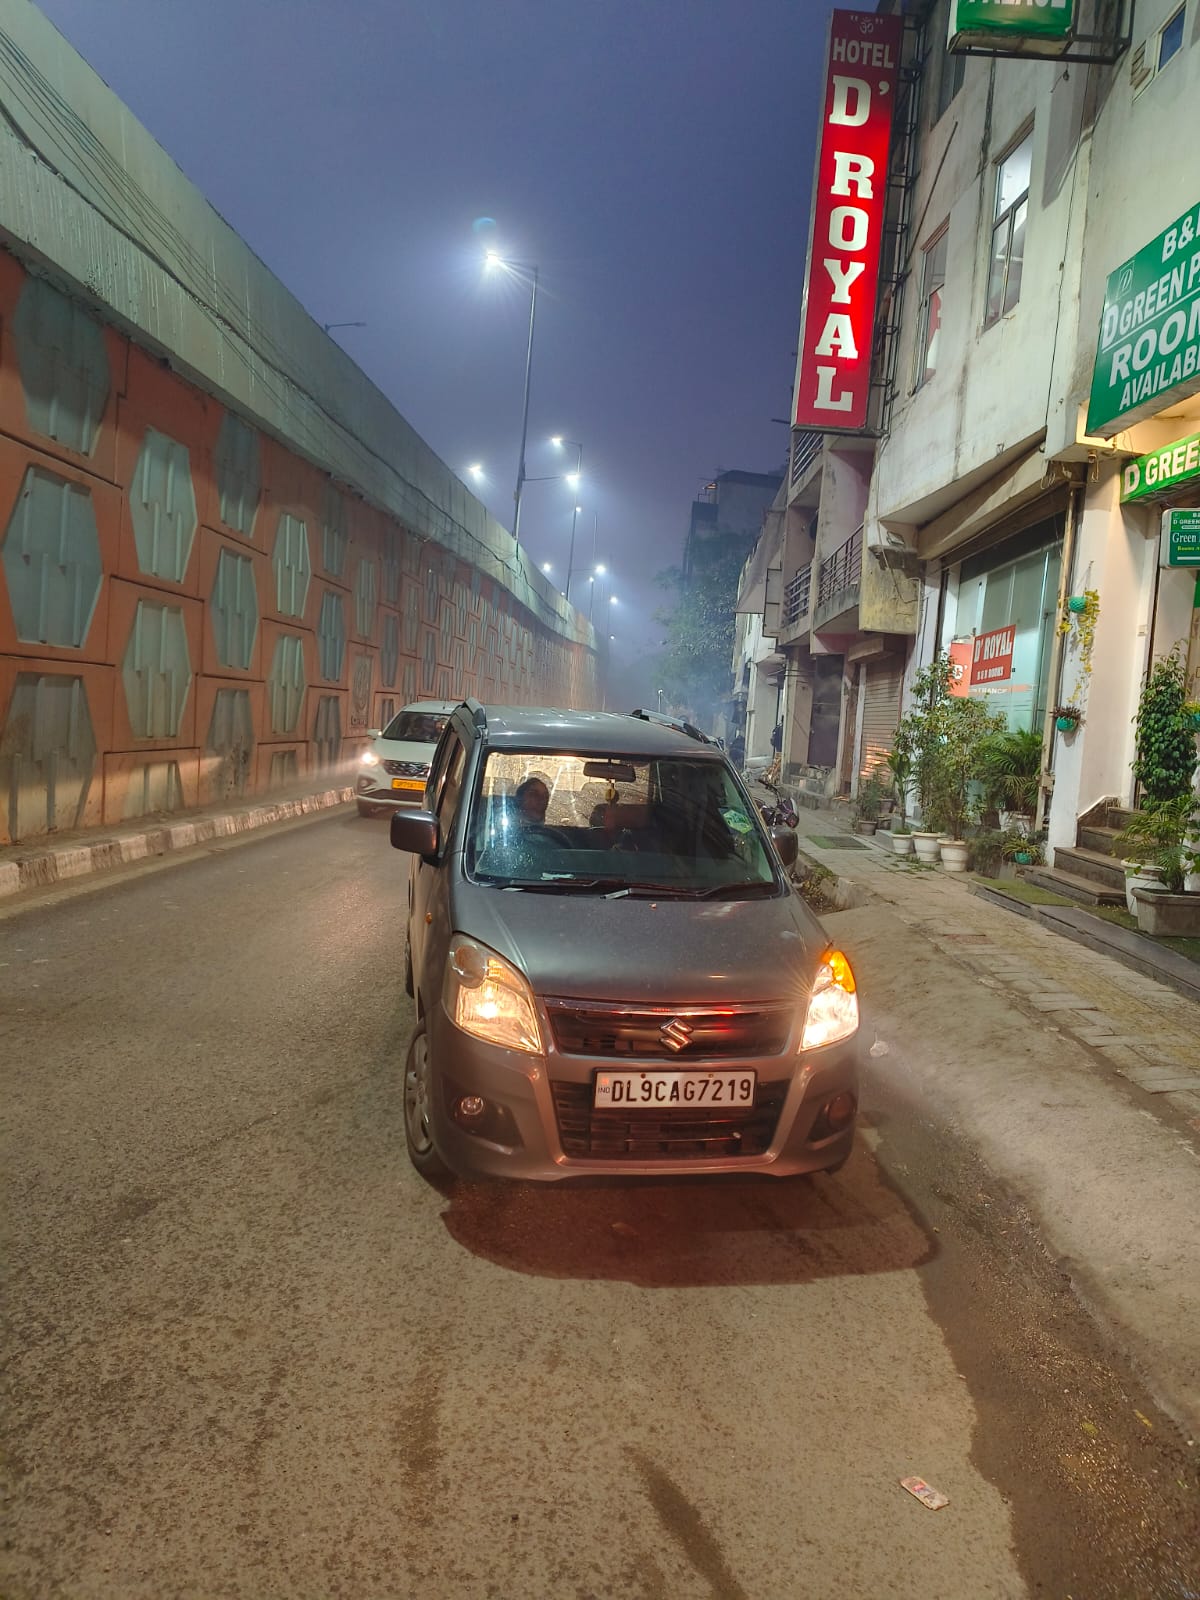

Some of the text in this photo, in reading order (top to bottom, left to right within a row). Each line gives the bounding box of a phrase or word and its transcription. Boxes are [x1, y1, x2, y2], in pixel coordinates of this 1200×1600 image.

[832, 37, 895, 69] HOTEL
[812, 150, 876, 412] ROYAL
[1187, 250, 1200, 290] P
[1124, 439, 1200, 496] D GREE
[1172, 532, 1197, 543] Green
[983, 630, 1012, 660] ROYAL
[611, 1079, 751, 1102] DL9CAG7219
